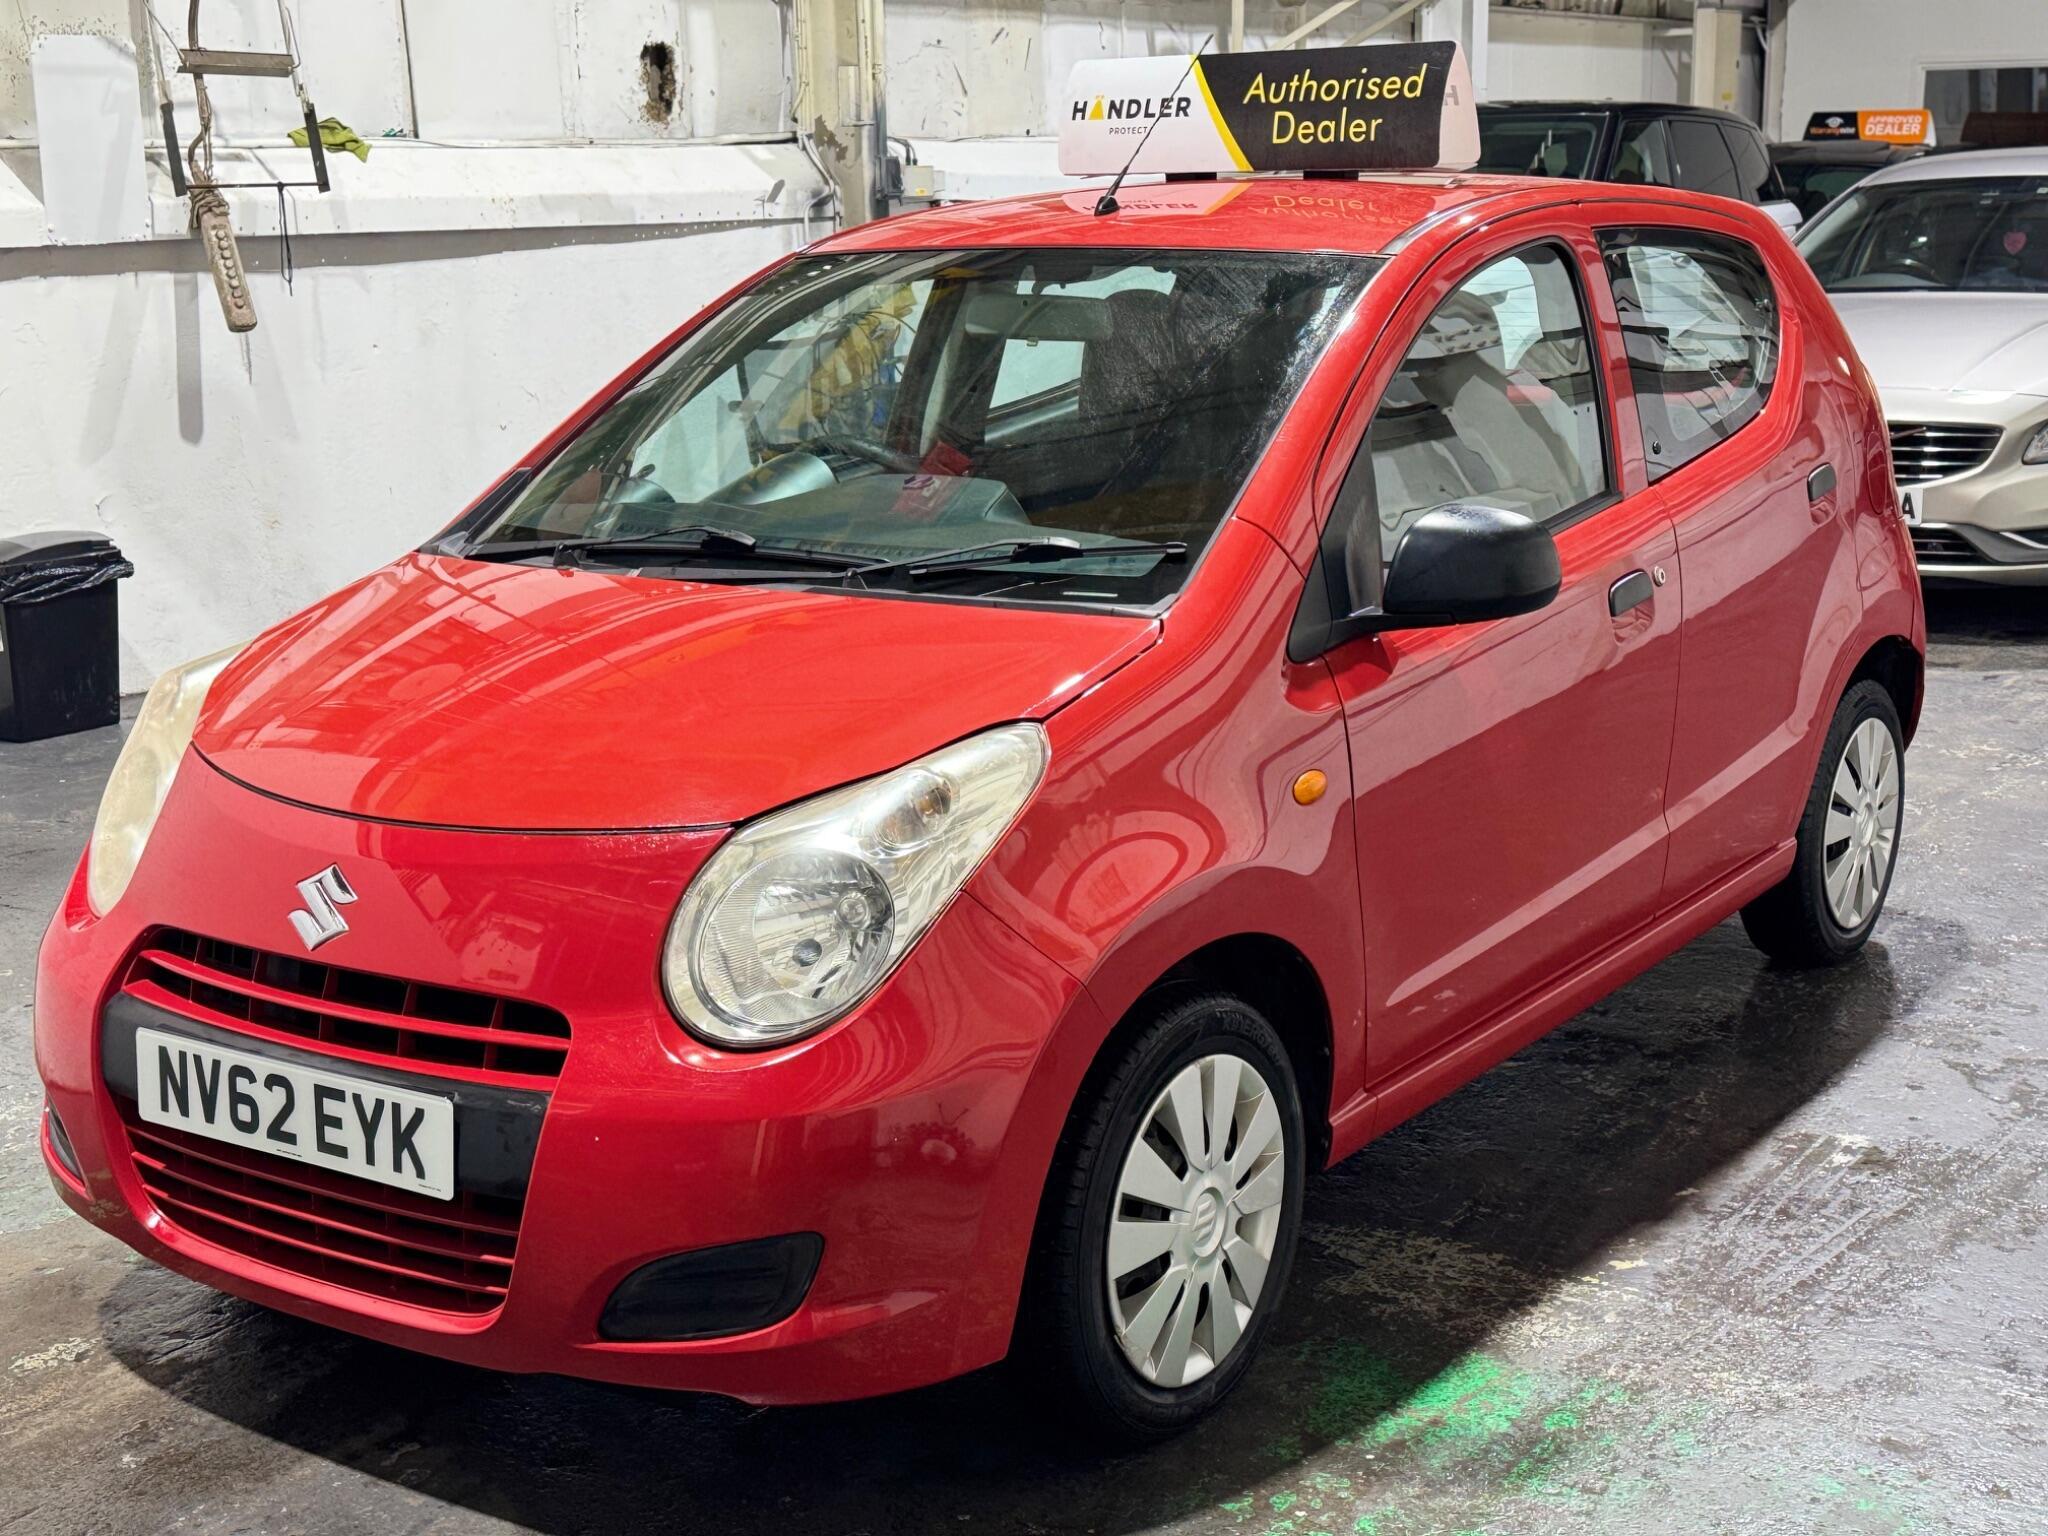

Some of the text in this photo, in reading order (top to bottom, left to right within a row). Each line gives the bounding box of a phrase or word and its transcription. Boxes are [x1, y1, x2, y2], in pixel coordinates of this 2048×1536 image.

[1243, 63, 1427, 104] Authorised
[1109, 126, 1148, 135] PROTECT
[1272, 107, 1383, 144] Dealer
[1865, 124, 1921, 136] DEALER
[1867, 115, 1922, 125] APPROVED
[158, 1045, 426, 1180] NV62 EYK
